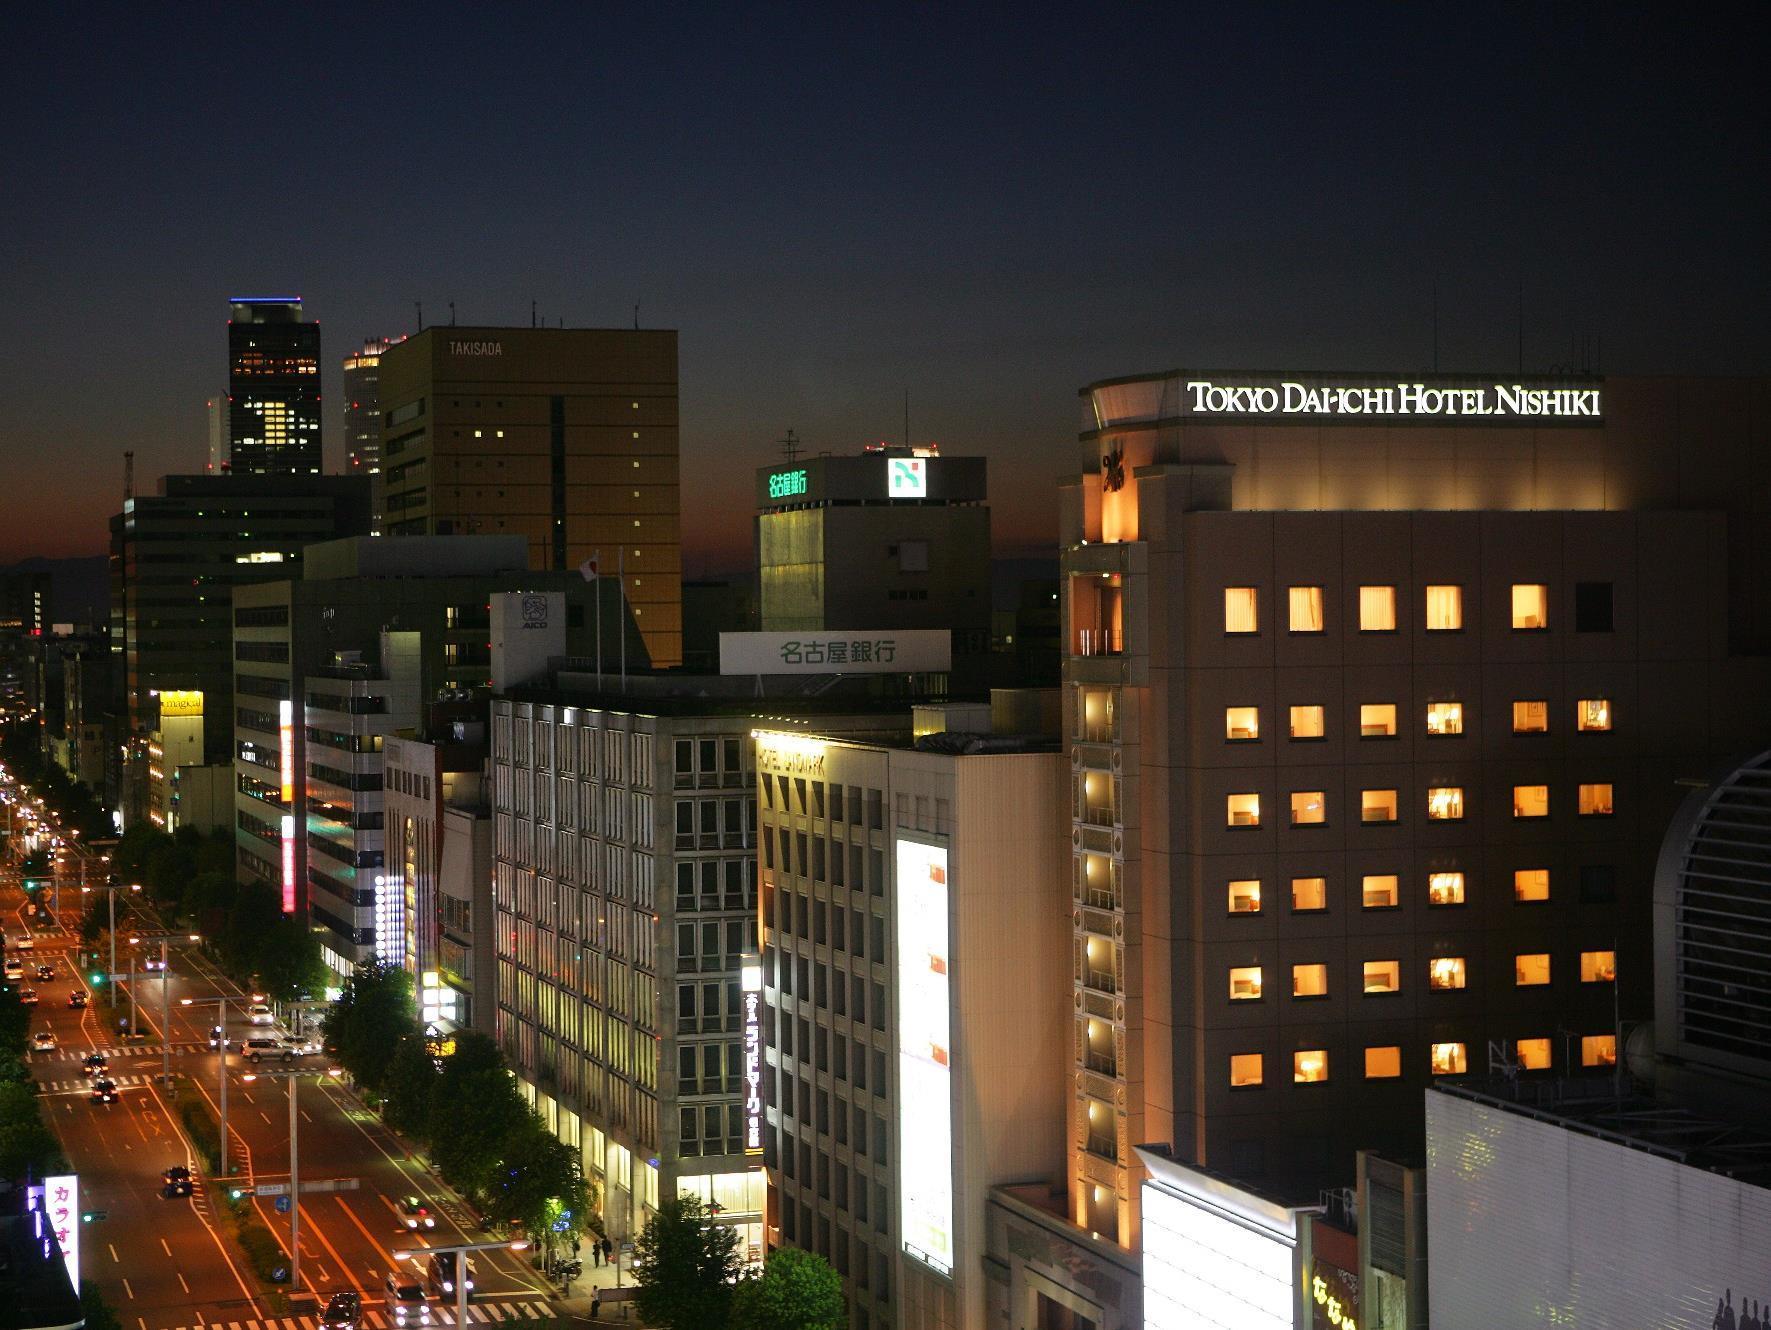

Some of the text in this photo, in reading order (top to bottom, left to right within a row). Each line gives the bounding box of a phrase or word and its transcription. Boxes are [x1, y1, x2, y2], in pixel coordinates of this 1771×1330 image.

[448, 341, 503, 356] TAKISADA
[1186, 381, 1601, 415] TOKYO DAI-ICHI HOTEL NISHIKI
[769, 469, 807, 498] 名古屋銀行
[779, 640, 896, 665] 名古屋銀行
